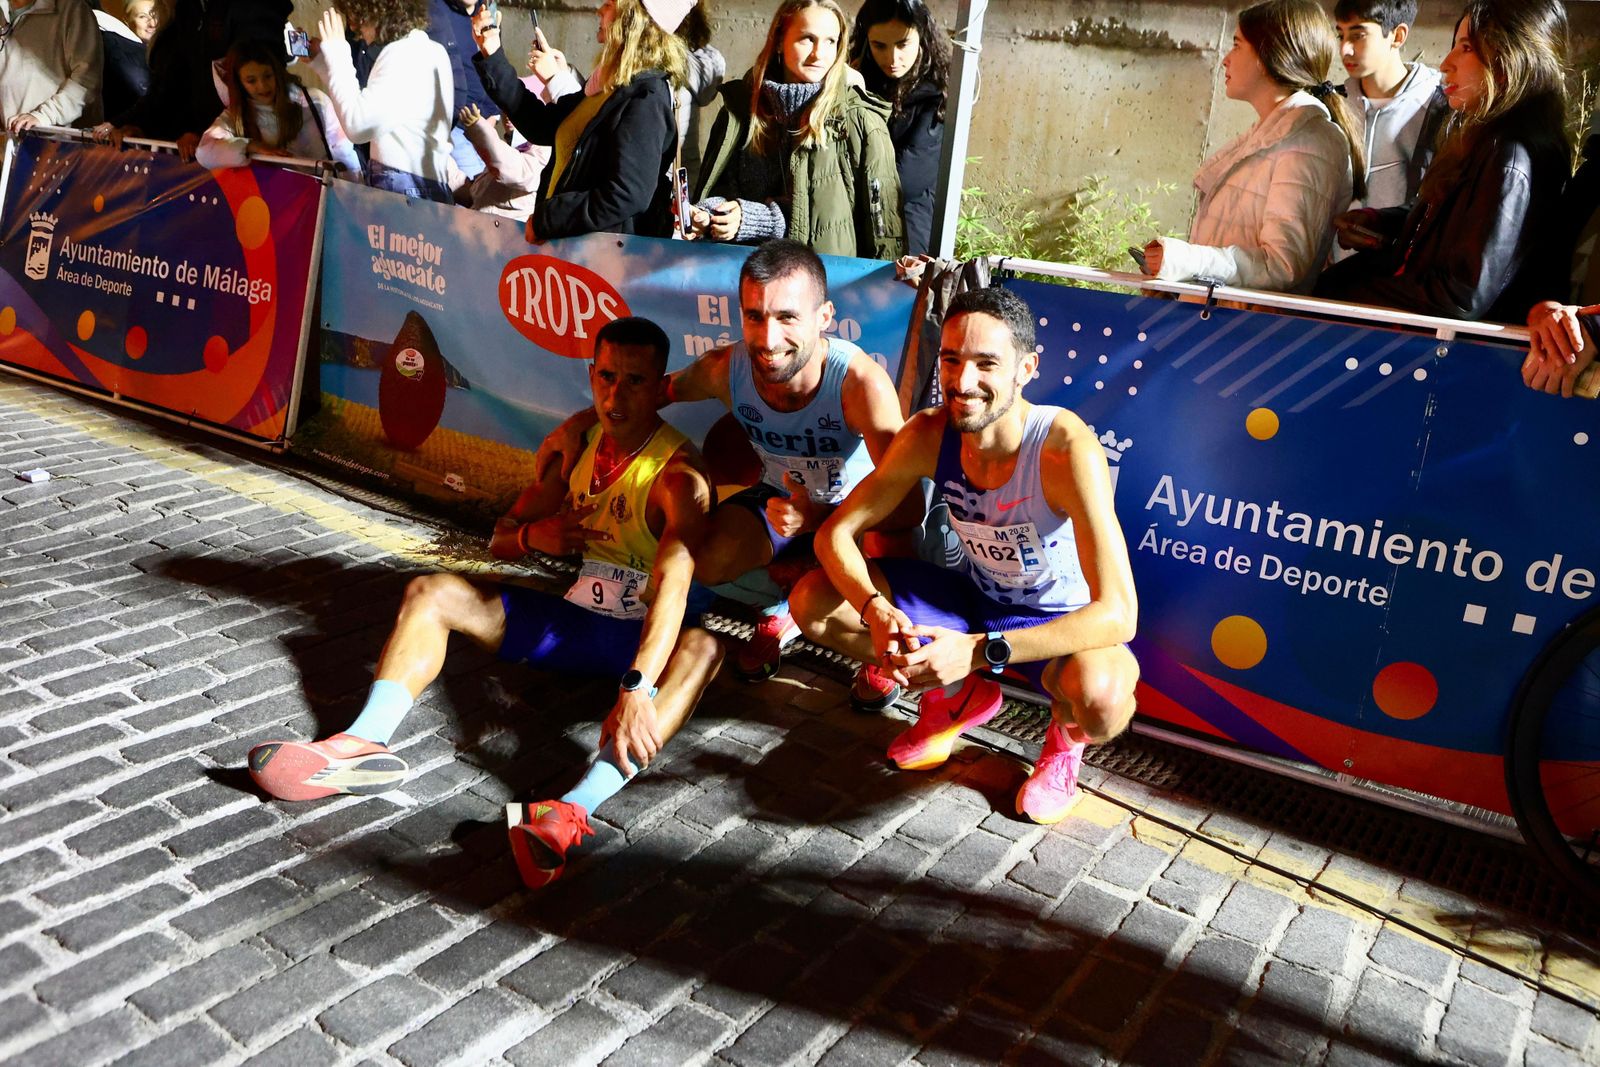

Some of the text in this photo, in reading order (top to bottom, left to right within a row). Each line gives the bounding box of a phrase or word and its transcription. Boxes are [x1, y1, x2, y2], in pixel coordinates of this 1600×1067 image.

[367, 224, 443, 266] El mejor
[56, 263, 133, 296] Área de Deporte
[59, 235, 272, 304] Ayuntamiento de Málaga
[371, 250, 447, 296] aguacate
[505, 266, 618, 339] TROPS
[696, 294, 732, 327] El
[806, 460, 820, 470] M
[965, 539, 1019, 562] 1162
[993, 530, 1009, 542] M
[1144, 474, 1596, 600] Ayuntamiento de
[611, 568, 625, 582] M
[1137, 522, 1389, 607] Área de Deporte
[591, 581, 604, 605] 9
